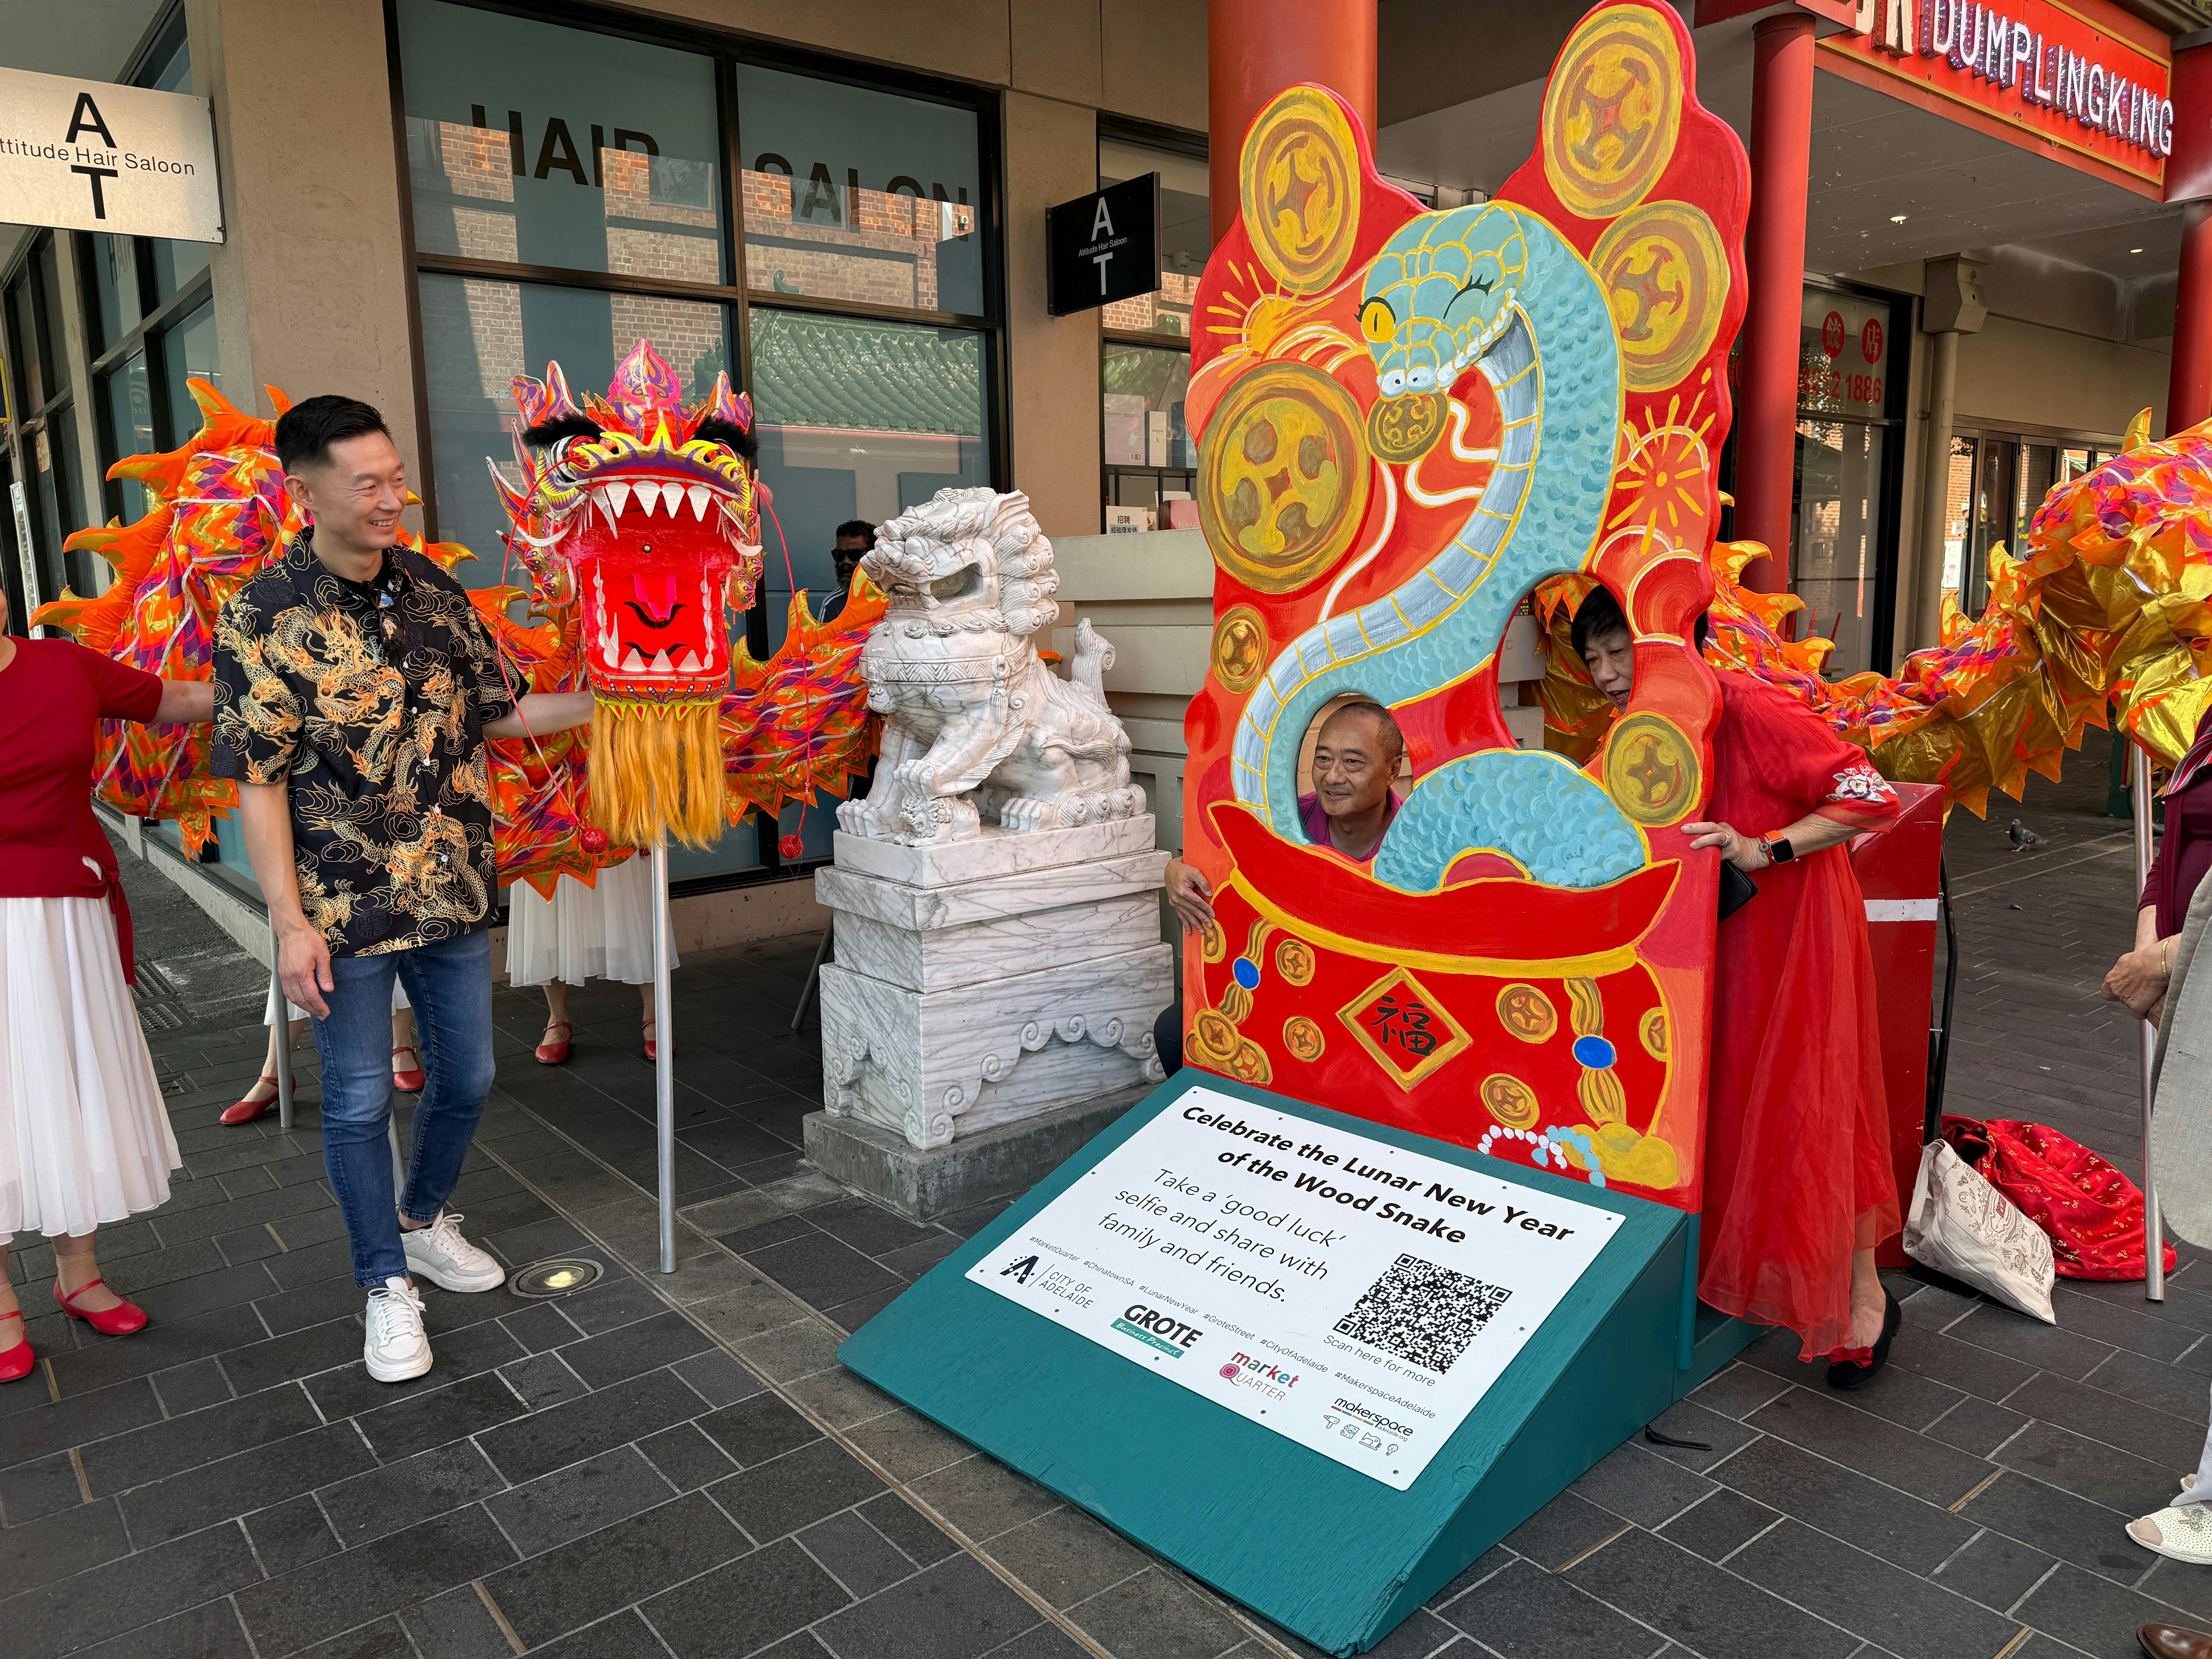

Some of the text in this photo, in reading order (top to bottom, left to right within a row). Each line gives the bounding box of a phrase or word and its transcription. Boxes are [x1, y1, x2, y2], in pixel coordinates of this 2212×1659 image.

[65, 92, 117, 149] A
[76, 147, 117, 167] Hair
[125, 153, 195, 176] Saloon
[471, 104, 663, 197] HAIR
[71, 165, 118, 220] T
[754, 153, 968, 242] SALON
[1091, 197, 1114, 242] A
[1079, 236, 1127, 257] Attitude Hair Saloon
[1093, 252, 1113, 295] T
[1800, 367, 1882, 404] 8212 1886
[1117, 515, 1130, 524] 招聘
[1371, 995, 1437, 1056] 福
[1154, 1168, 1200, 1195] Take
[1202, 1192, 1216, 1202] a
[1183, 1107, 1575, 1240] Celebrate the Lunar New Year
[1218, 1152, 1465, 1243] of the Wood Snake
[1115, 1191, 1328, 1280] selfie and share with
[1098, 1213, 1285, 1302] family and friends.
[1038, 1280, 1094, 1309] ADELAIDE
[1049, 1272, 1092, 1293] CITY OF
[1029, 1237, 1435, 1419] #MarketQuarter #ChinatownSA #LunarNewYear #GroteStreet #CityOfAdelaide #MakerspaceAdelaide
[1116, 1322, 1185, 1355] Business Precinct
[1124, 1305, 1204, 1348] GROTE
[1230, 1352, 1299, 1388] market
[1324, 1335, 1435, 1386] Scan here for more
[1335, 1398, 1413, 1436] makerspace
[1377, 1426, 1408, 1442] adelaide.org
